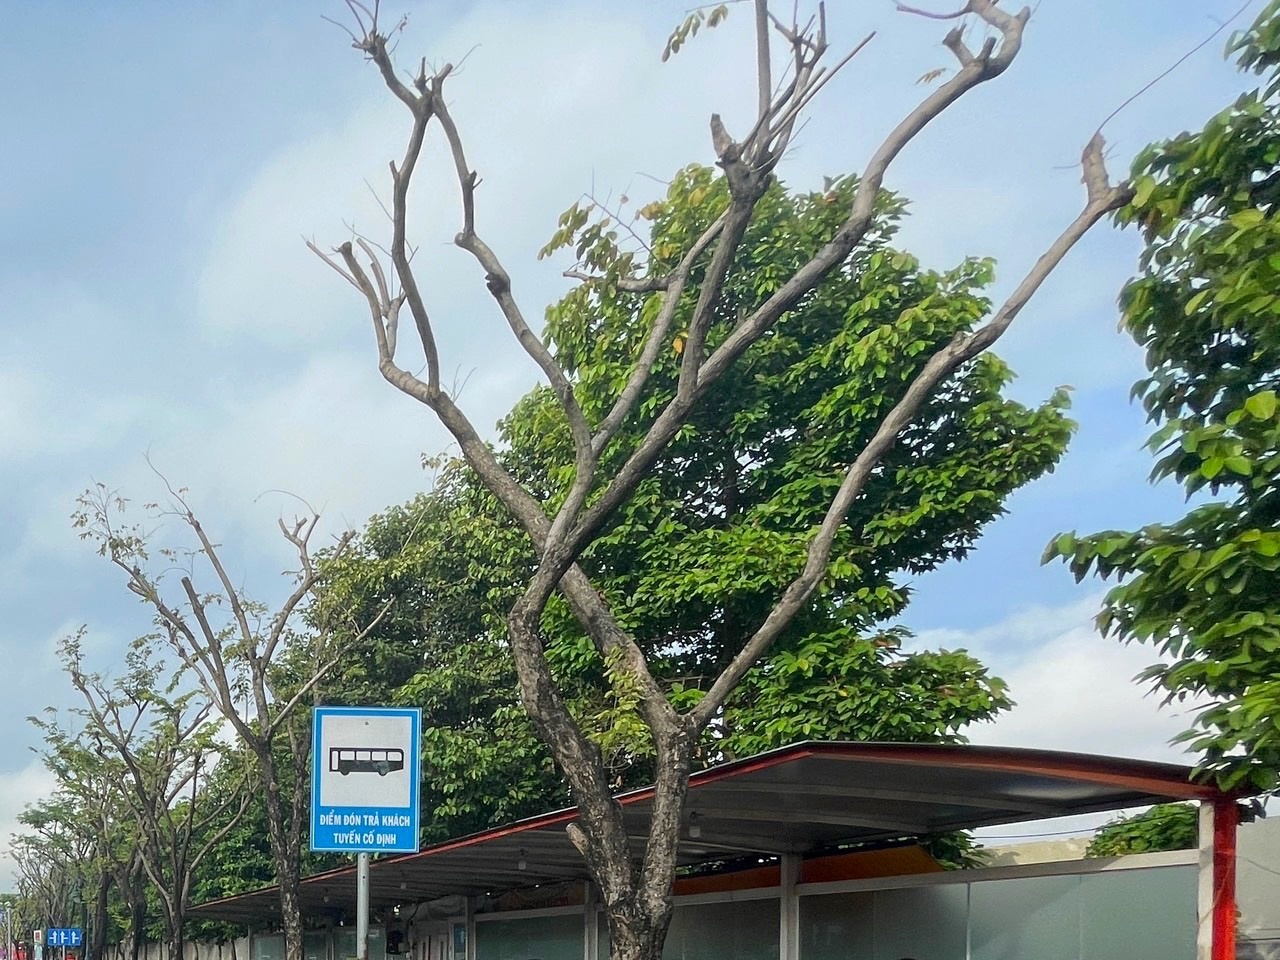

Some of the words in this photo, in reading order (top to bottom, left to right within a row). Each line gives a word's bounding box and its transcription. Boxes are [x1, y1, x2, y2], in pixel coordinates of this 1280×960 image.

[320, 809, 341, 825] ĐIỂM
[344, 812, 360, 826] ĐÓN
[363, 810, 379, 826] TRẢ
[382, 813, 410, 826] KHÁCH
[333, 829, 360, 844] TUYẾN
[363, 829, 375, 844] CỐ
[377, 834, 396, 847] ĐỊNH
